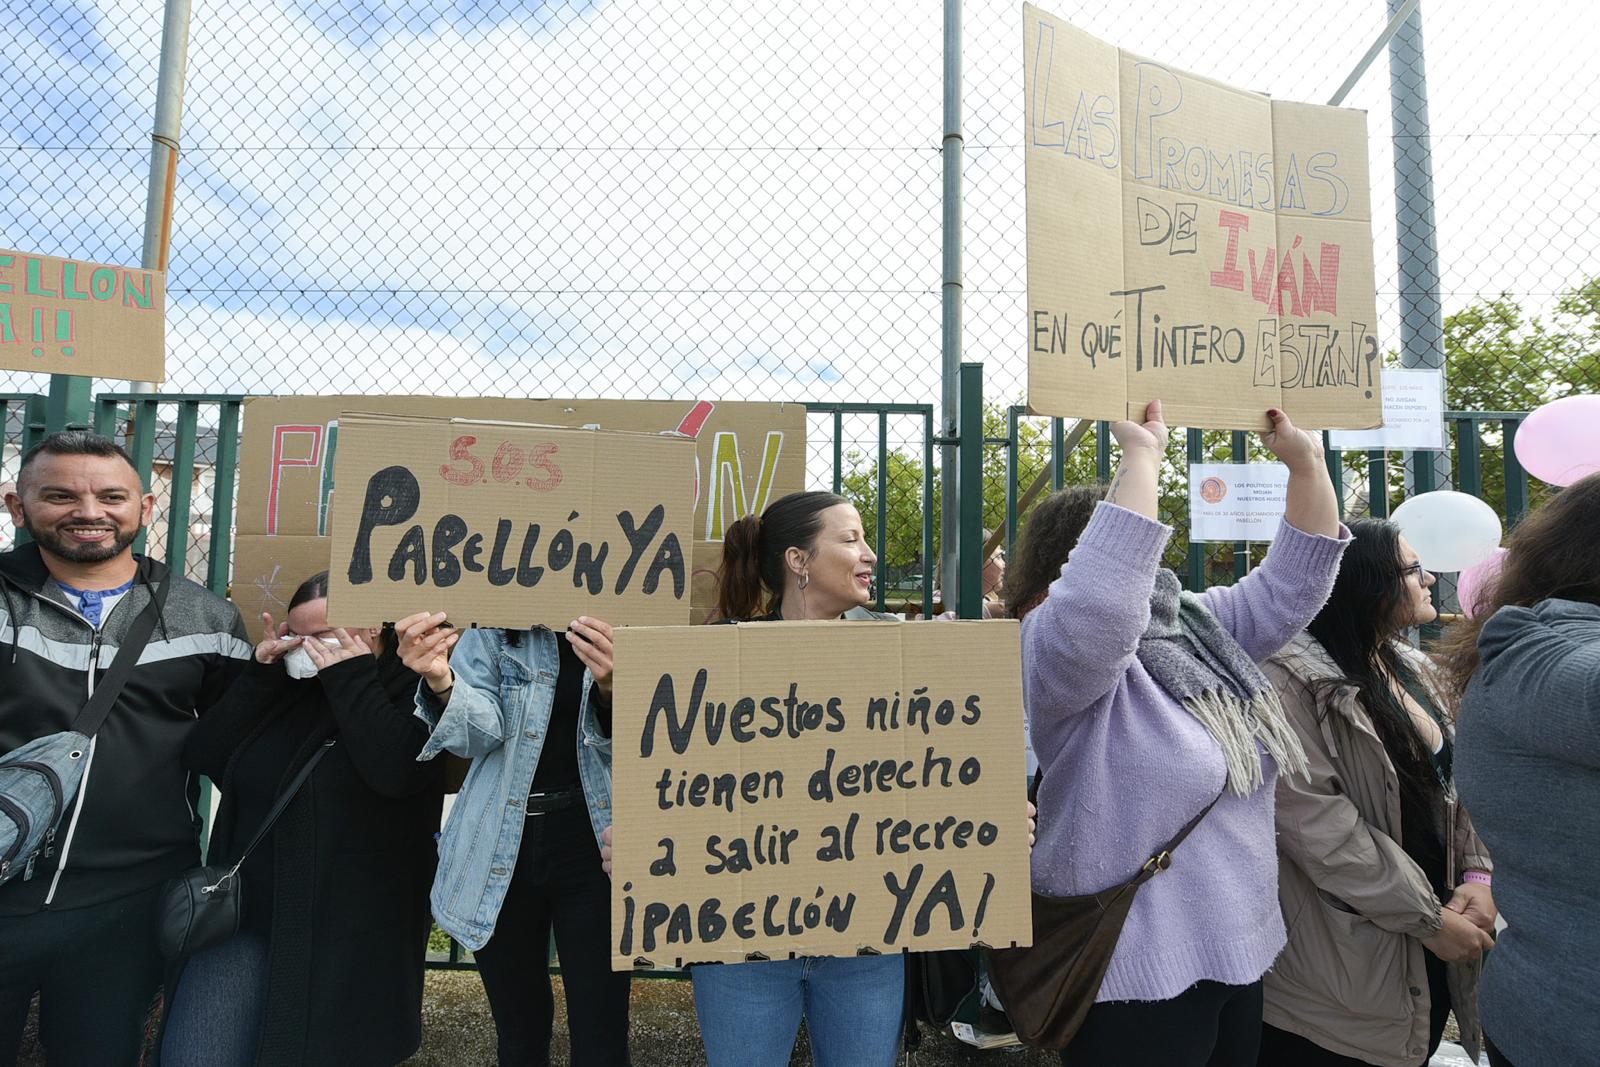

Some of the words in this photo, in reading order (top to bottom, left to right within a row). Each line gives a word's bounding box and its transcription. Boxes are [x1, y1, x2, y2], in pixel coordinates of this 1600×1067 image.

[1034, 21, 1120, 169] LAS
[1134, 62, 1349, 215] PROMESAS
[1136, 197, 1198, 255] DE
[1210, 209, 1340, 317] IVÁN
[1034, 311, 1068, 355] EN
[1081, 309, 1123, 370] QUÉ
[1253, 318, 1381, 400] ESTÁN?
[348, 466, 610, 595] PABELLÓN
[615, 504, 685, 599] YA
[640, 668, 845, 757] Nuestros
[866, 686, 981, 734] niños
[655, 768, 784, 812] tienen
[808, 747, 981, 802] derecho
[649, 837, 676, 876] a
[705, 824, 798, 874] salir
[816, 813, 860, 862] al
[876, 815, 998, 855] recreo
[620, 881, 856, 955] ¡PABELLÓN
[883, 863, 995, 944] YA!
